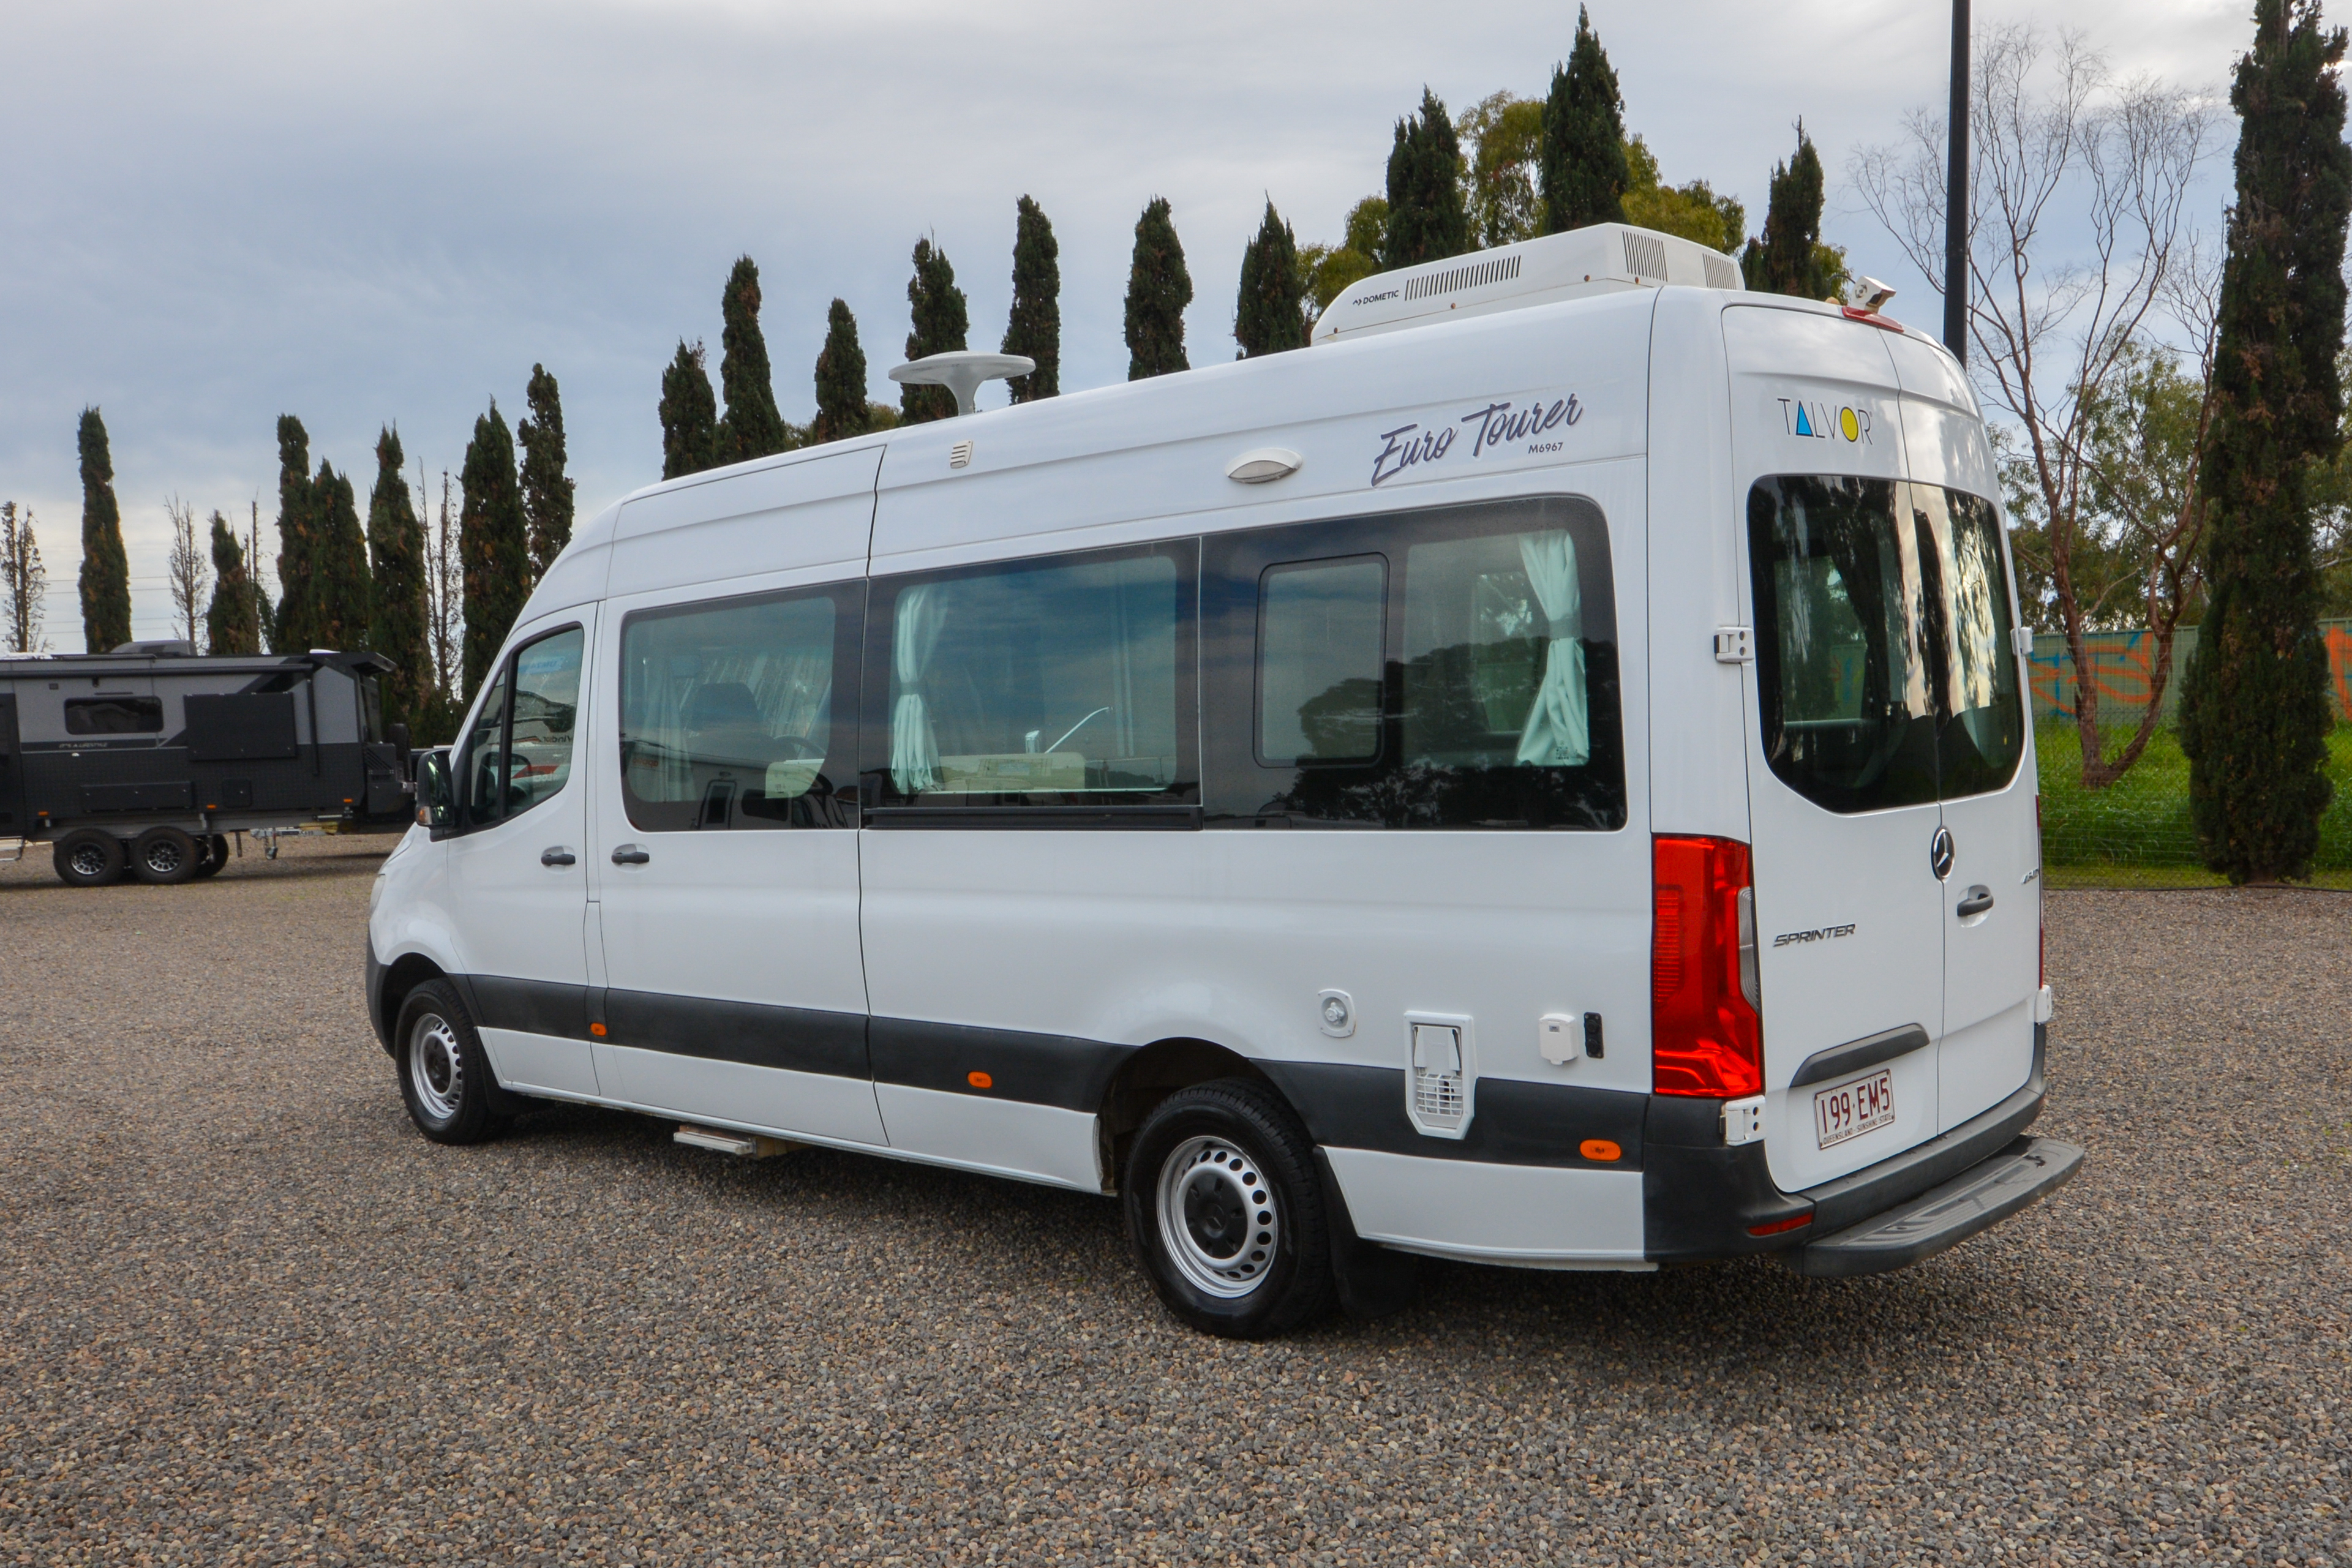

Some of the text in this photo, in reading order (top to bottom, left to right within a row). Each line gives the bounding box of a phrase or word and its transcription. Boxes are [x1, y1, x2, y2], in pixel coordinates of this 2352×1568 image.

[1363, 290, 1399, 304] DOMETIC
[1777, 398, 1873, 446] TALVOR
[1371, 393, 1584, 487] Euro Tourer
[1528, 442, 1564, 454] M6967
[1773, 923, 1855, 947] SPRINTER
[1823, 1127, 1854, 1145] QUEENSLAND
[1857, 1117, 1877, 1133] SUNSHINE
[1879, 1112, 1892, 1124] STATE
